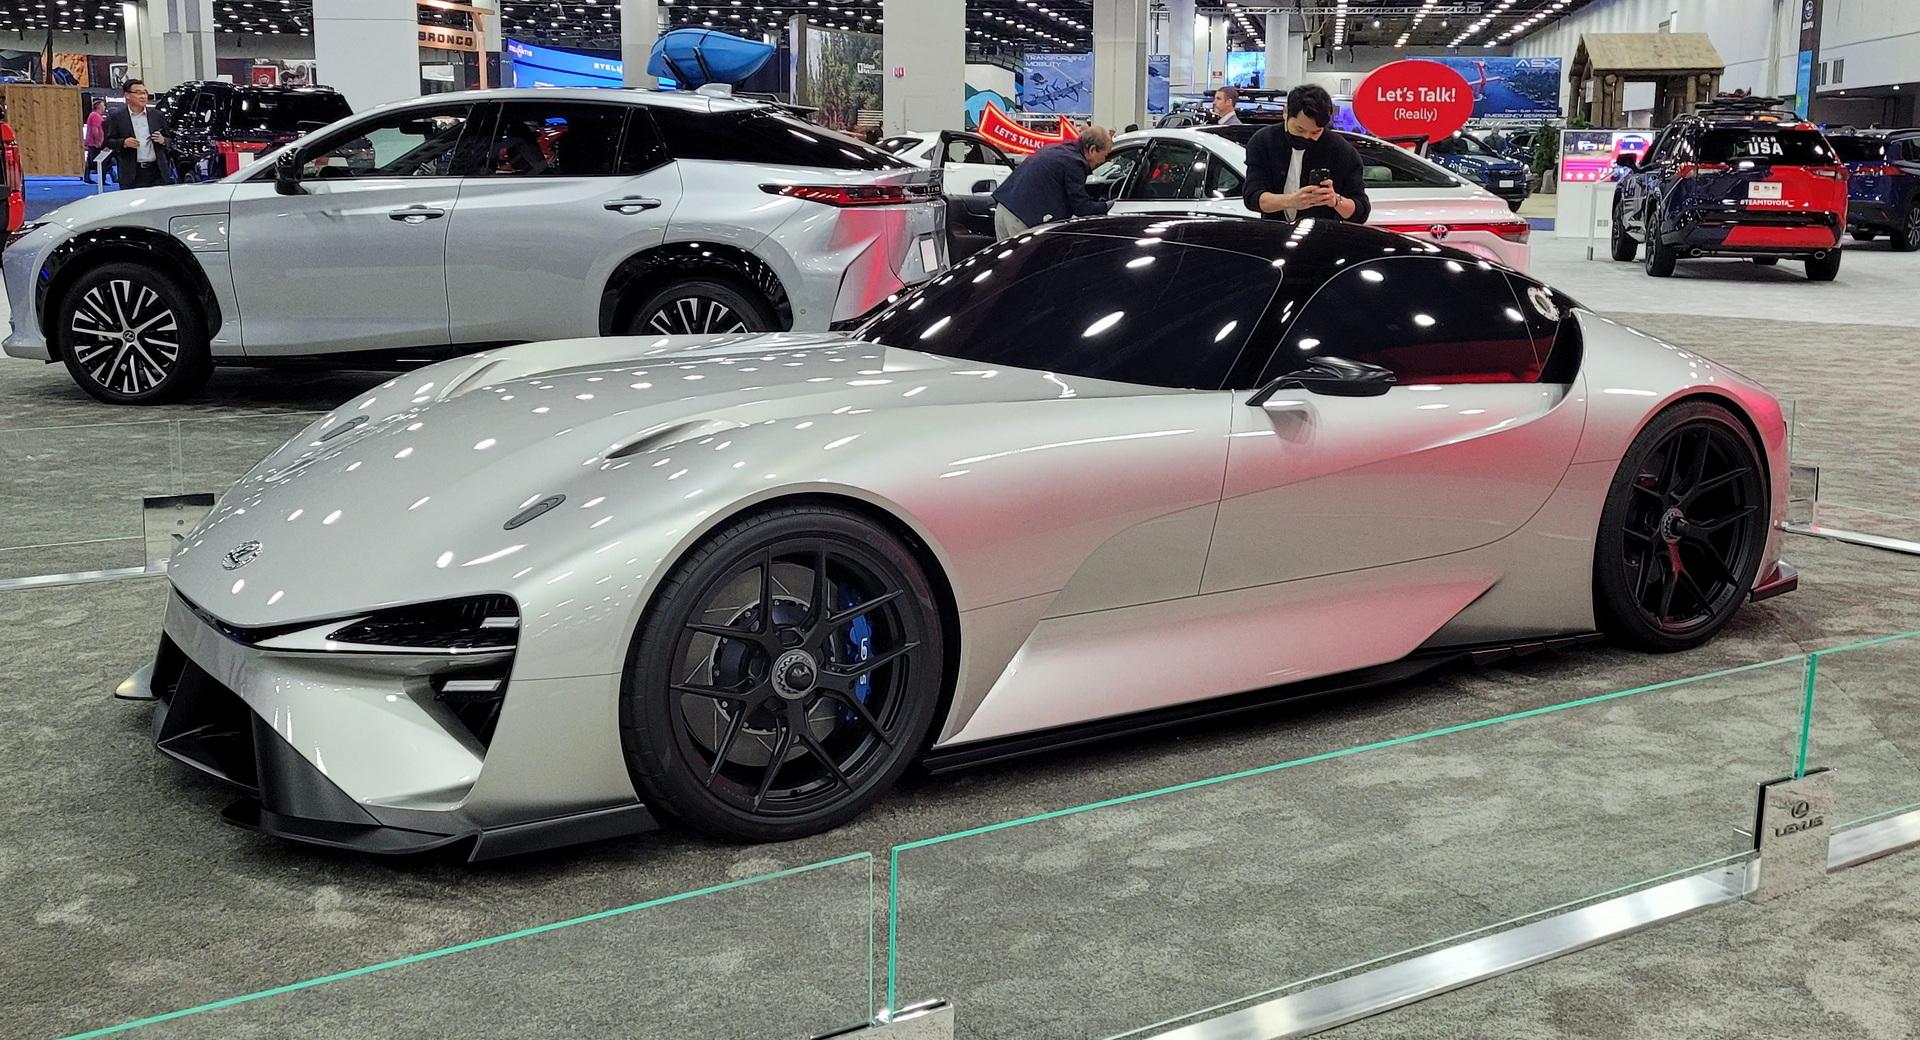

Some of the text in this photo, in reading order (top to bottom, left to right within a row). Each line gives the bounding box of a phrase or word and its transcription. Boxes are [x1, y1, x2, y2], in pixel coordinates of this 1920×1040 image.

[418, 31, 473, 47] BRONCO
[1515, 59, 1560, 67] ASX
[1377, 86, 1457, 103] Let's Talk!
[1394, 107, 1438, 122] (Really)
[993, 124, 1018, 142] LET'S
[1748, 142, 1784, 155] USA
[1775, 816, 1824, 837] LEXUS
